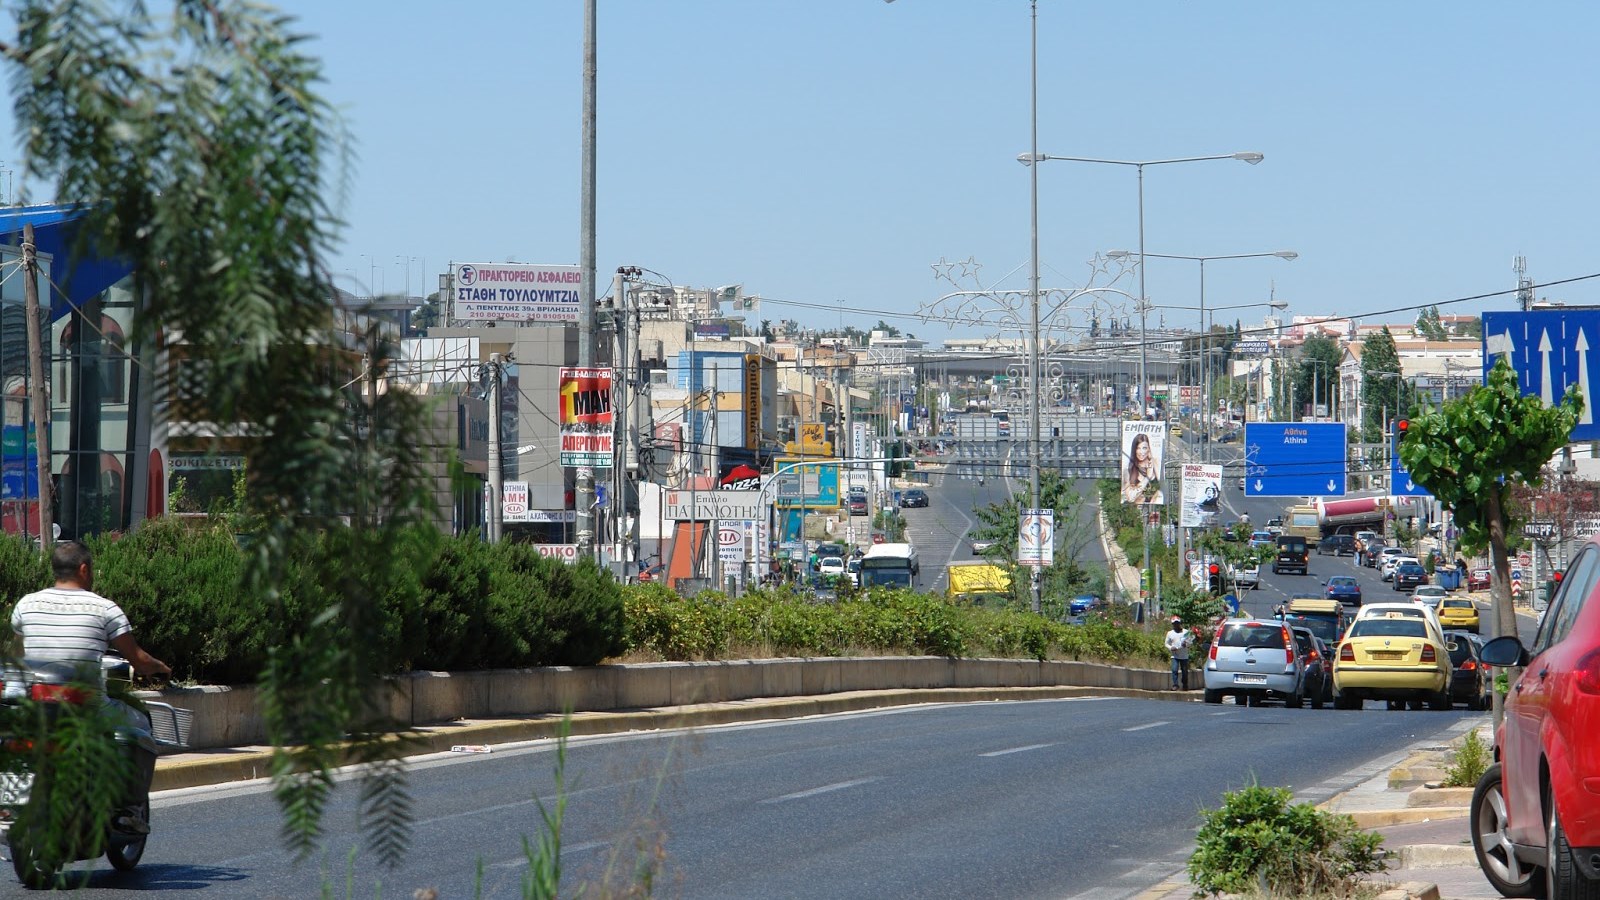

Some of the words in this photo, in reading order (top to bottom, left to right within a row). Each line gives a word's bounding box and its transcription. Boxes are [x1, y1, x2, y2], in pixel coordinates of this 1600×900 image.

[479, 270, 535, 283] ΠΡΑΚΤΟΡΕΙΟ
[458, 287, 496, 301] ΣΤΑΘΗ
[561, 381, 579, 425] 1
[573, 389, 611, 416] ΜΑΗ
[563, 435, 611, 451] ΑΠΕΡΓΟΥΜΕ
[1283, 436, 1308, 444] Athina
